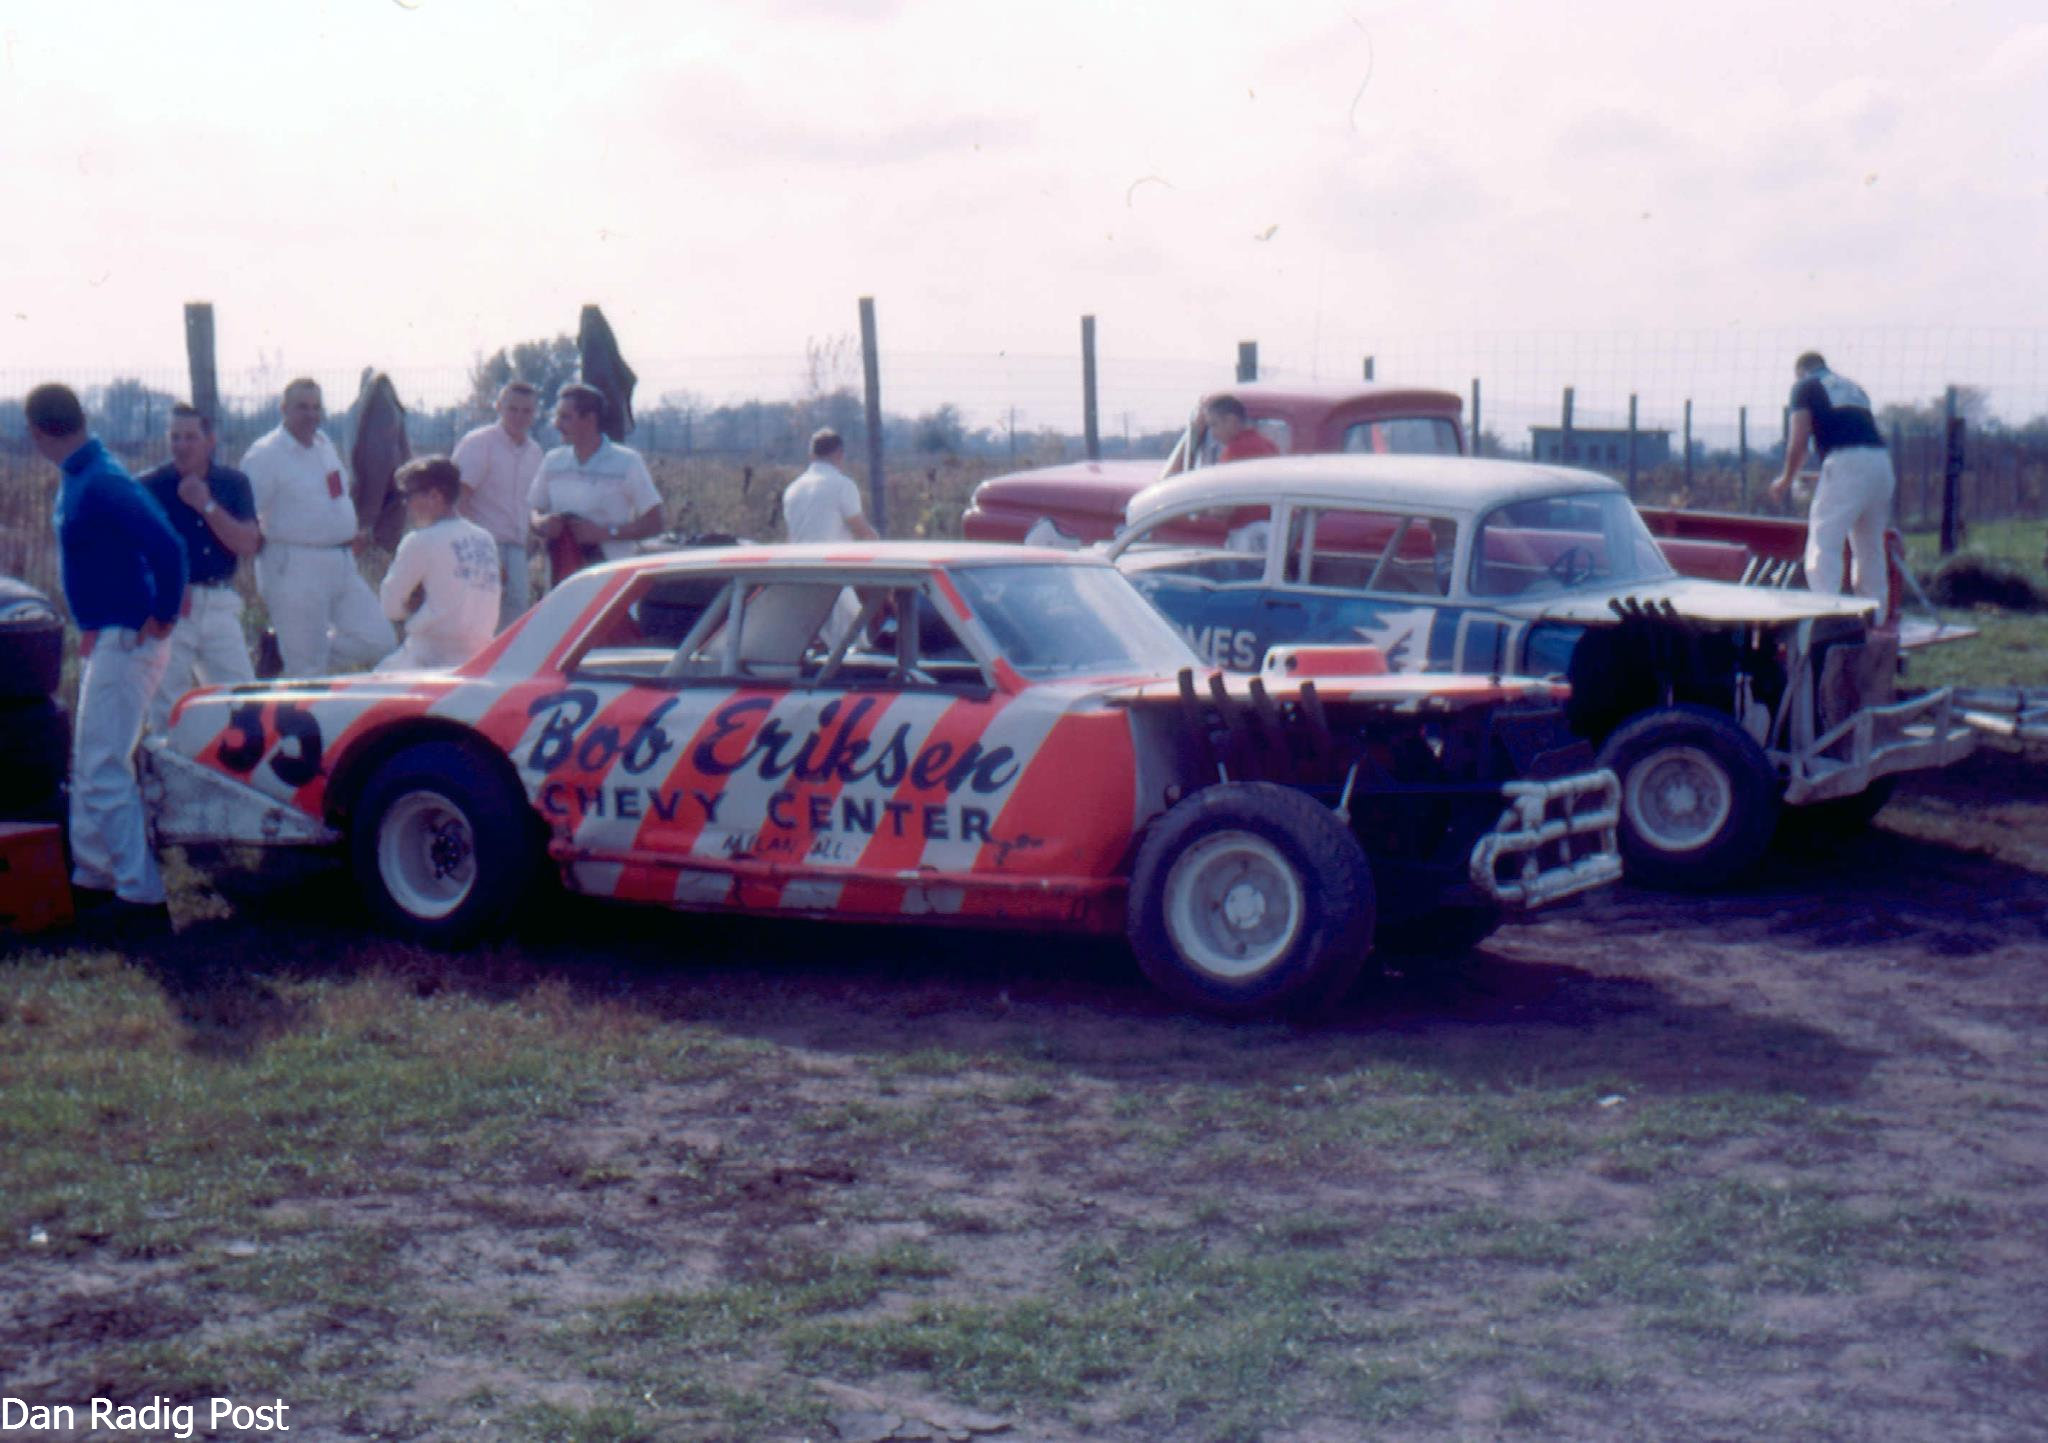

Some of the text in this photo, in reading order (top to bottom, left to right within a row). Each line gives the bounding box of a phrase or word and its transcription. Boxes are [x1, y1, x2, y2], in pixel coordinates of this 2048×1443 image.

[527, 689, 1020, 794] Bob Eriksen
[545, 783, 993, 844] CHEVY CENTER
